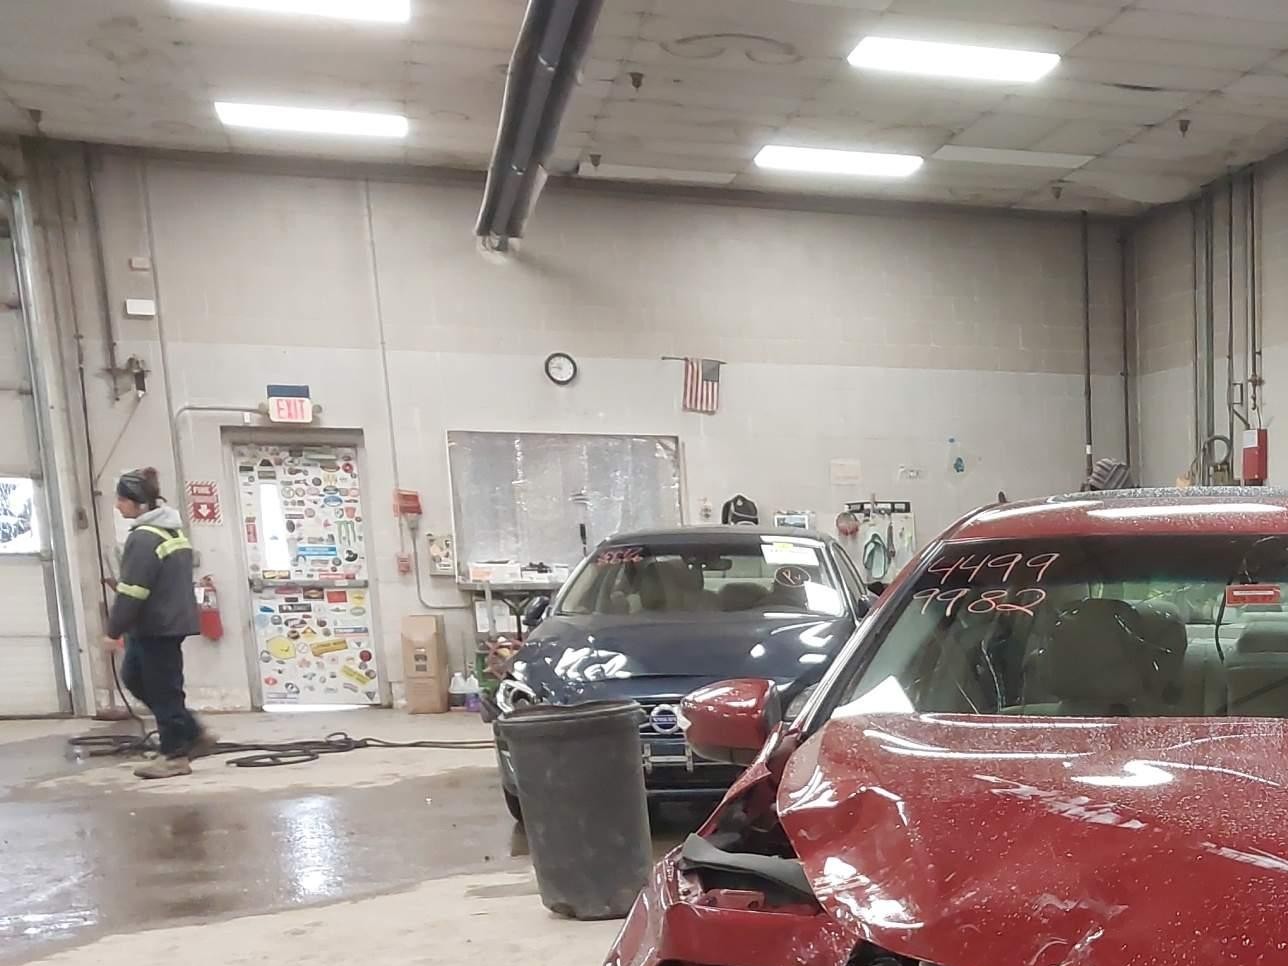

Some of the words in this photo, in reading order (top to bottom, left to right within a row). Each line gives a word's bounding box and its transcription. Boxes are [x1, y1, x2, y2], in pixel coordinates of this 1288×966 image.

[276, 399, 305, 419] EXIT
[927, 552, 1060, 584] 4499
[912, 587, 1046, 617] 9982
